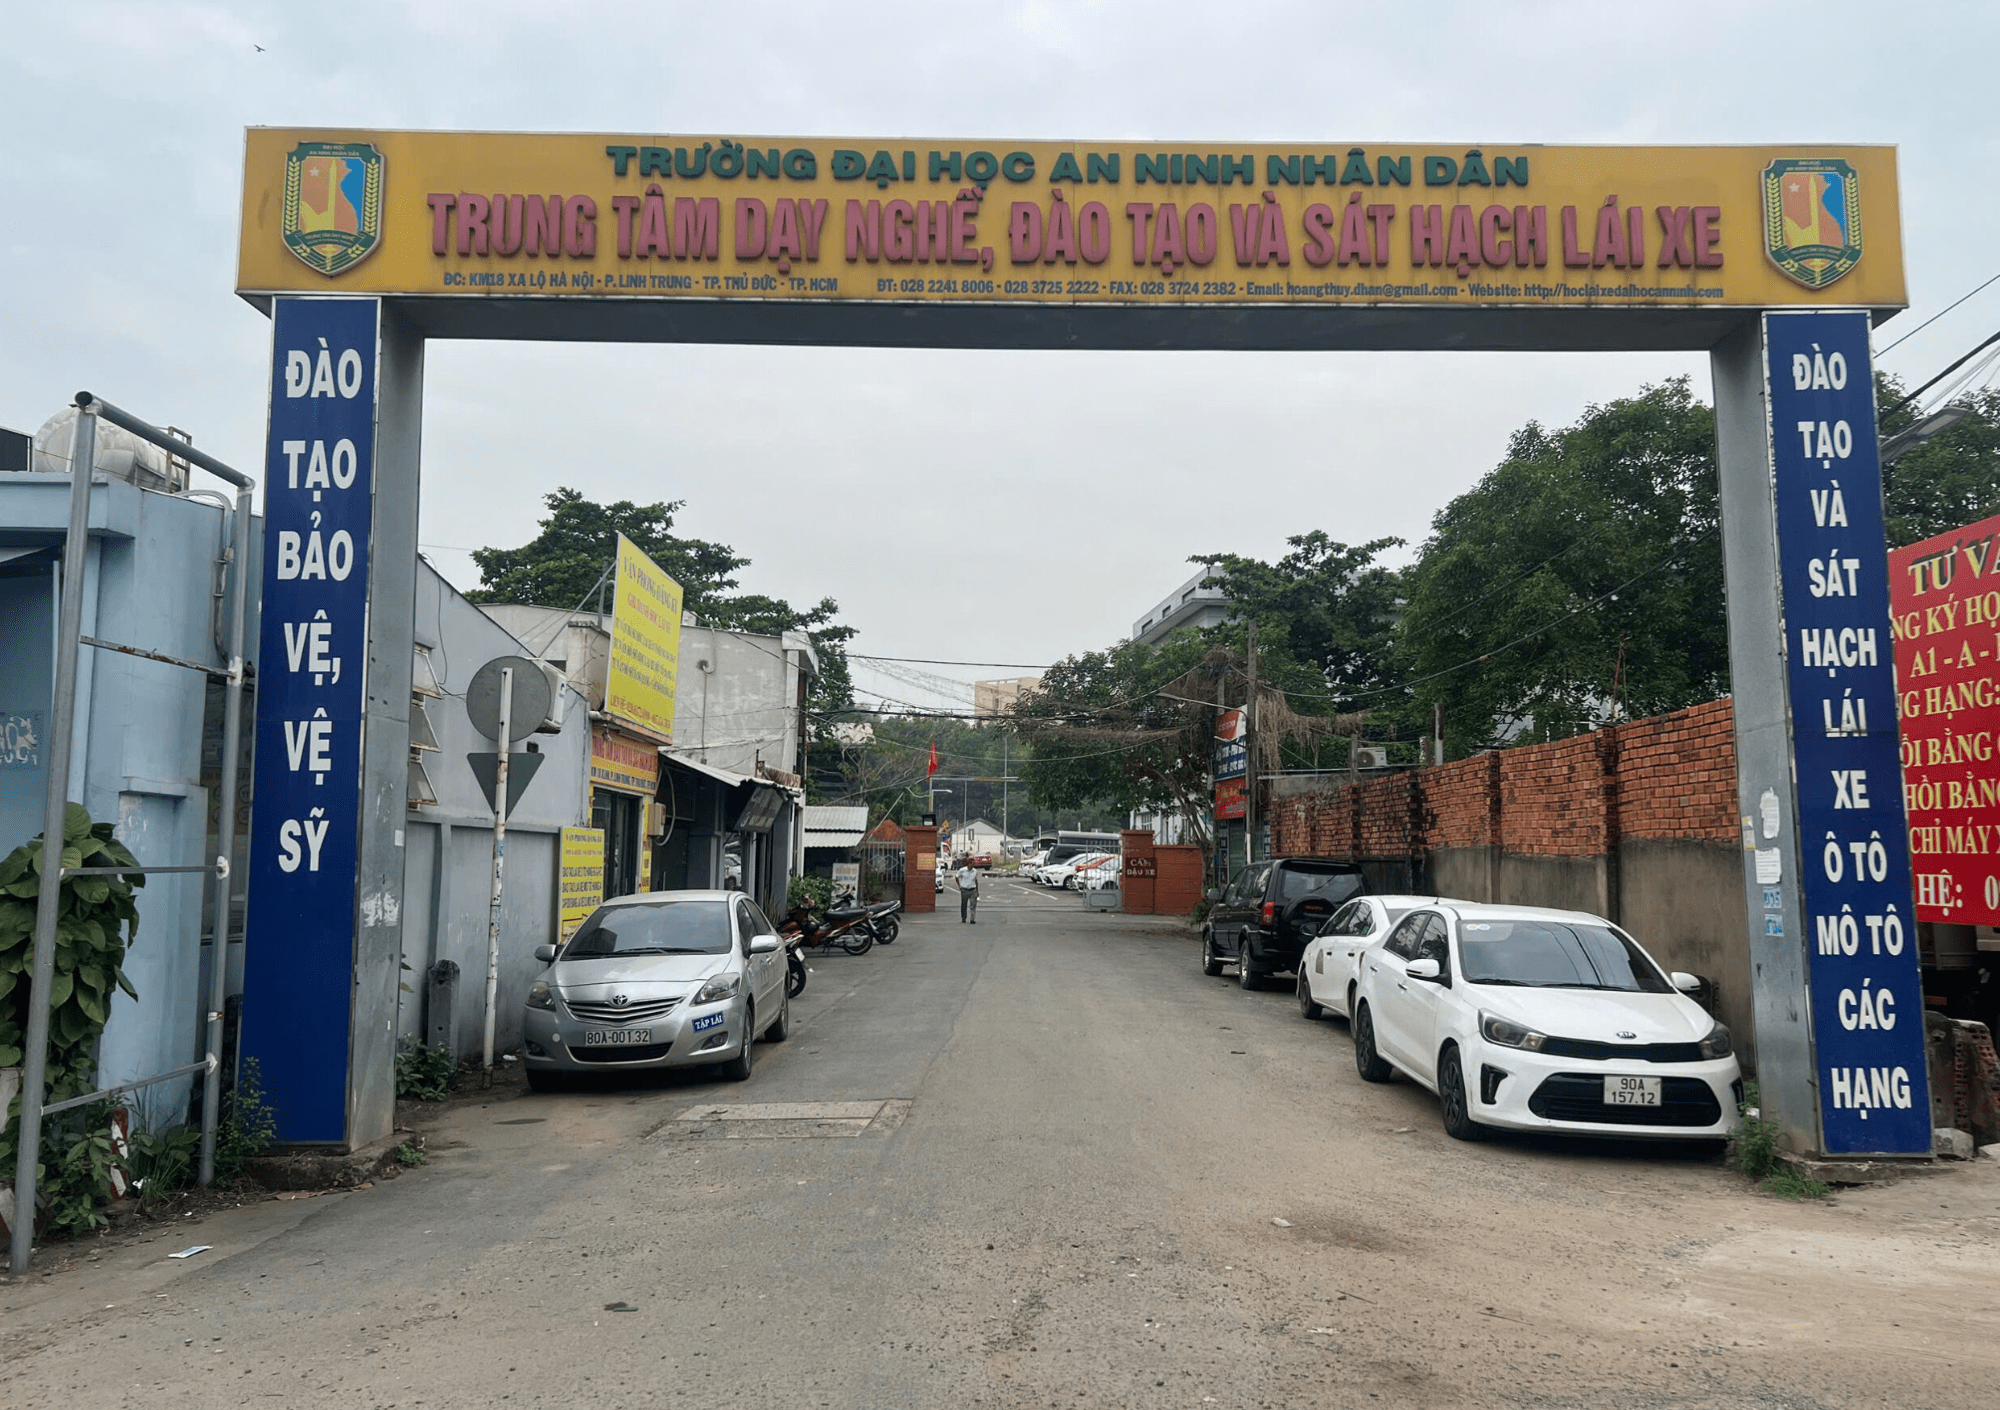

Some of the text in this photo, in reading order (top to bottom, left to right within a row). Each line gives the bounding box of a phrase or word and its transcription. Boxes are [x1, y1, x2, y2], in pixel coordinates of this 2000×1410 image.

[604, 141, 1529, 190] TRƯỜNG ĐẠI HỌC AN NINH NHÂN DÂN
[427, 183, 1725, 276] TRUNG TÂM DẠY NGHỀ, ĐÀO TẠO VÀ SÁT HẠCH LÁI XE
[443, 272, 466, 286] ĐC:
[508, 272, 526, 287] XA
[530, 270, 546, 289] LỘ
[550, 272, 567, 287] HÀ
[571, 271, 595, 290] NỘI
[650, 275, 692, 289] TRUNG
[702, 276, 721, 290] TP.
[751, 274, 777, 291] ĐỨC
[789, 277, 807, 291] TP.
[809, 277, 838, 292] HCM
[877, 279, 898, 293] ĐT:
[900, 279, 925, 294] 028
[927, 279, 959, 294] 2241
[961, 280, 994, 294] 8006
[1004, 280, 1029, 295] 028
[1031, 280, 1064, 295] 3725
[1066, 281, 1100, 295] 2222
[1110, 281, 1138, 296] FAX:
[1140, 281, 1165, 296] 028
[1168, 282, 1200, 296] 3724
[1203, 281, 1236, 296] 2382
[1247, 282, 1283, 296] Email:
[1468, 284, 1522, 297] Website:
[285, 337, 363, 399] ĐÀO
[1792, 343, 1848, 391] ĐÀO
[1797, 420, 1853, 470] TẠO
[282, 438, 357, 502] TẠO
[1810, 479, 1848, 527] VÀ
[277, 510, 354, 582] BẢO
[1907, 544, 1960, 597] TƯ
[1808, 549, 1860, 598] SÁT
[1925, 593, 1959, 635] KÝ
[283, 609, 342, 686] VỆ,
[1801, 627, 1878, 678] HẠCH
[1910, 647, 1937, 678] A1
[1957, 640, 1976, 670] A
[1823, 688, 1868, 737] LÁI
[1925, 677, 2000, 720] HẠNG:
[283, 707, 333, 786] VỆ
[1926, 728, 1992, 766] BẰNG
[1830, 770, 1870, 809] XE
[1948, 771, 2000, 810] BẰN
[278, 806, 330, 873] SỸ
[1823, 830, 1844, 883] Ô
[1849, 830, 1887, 883] TÔ
[1909, 818, 1942, 855] CHỈ
[1945, 816, 1991, 855] MÁY
[1916, 868, 1963, 917] HỆ:
[1816, 903, 1904, 956] MÔ TÔ
[1838, 978, 1896, 1031] CÁC
[587, 1030, 649, 1045] 80A-001.32
[1611, 1091, 1655, 1104] 157.12
[1620, 1078, 1645, 1091] 90A
[1831, 1066, 1912, 1120] HẠNG
